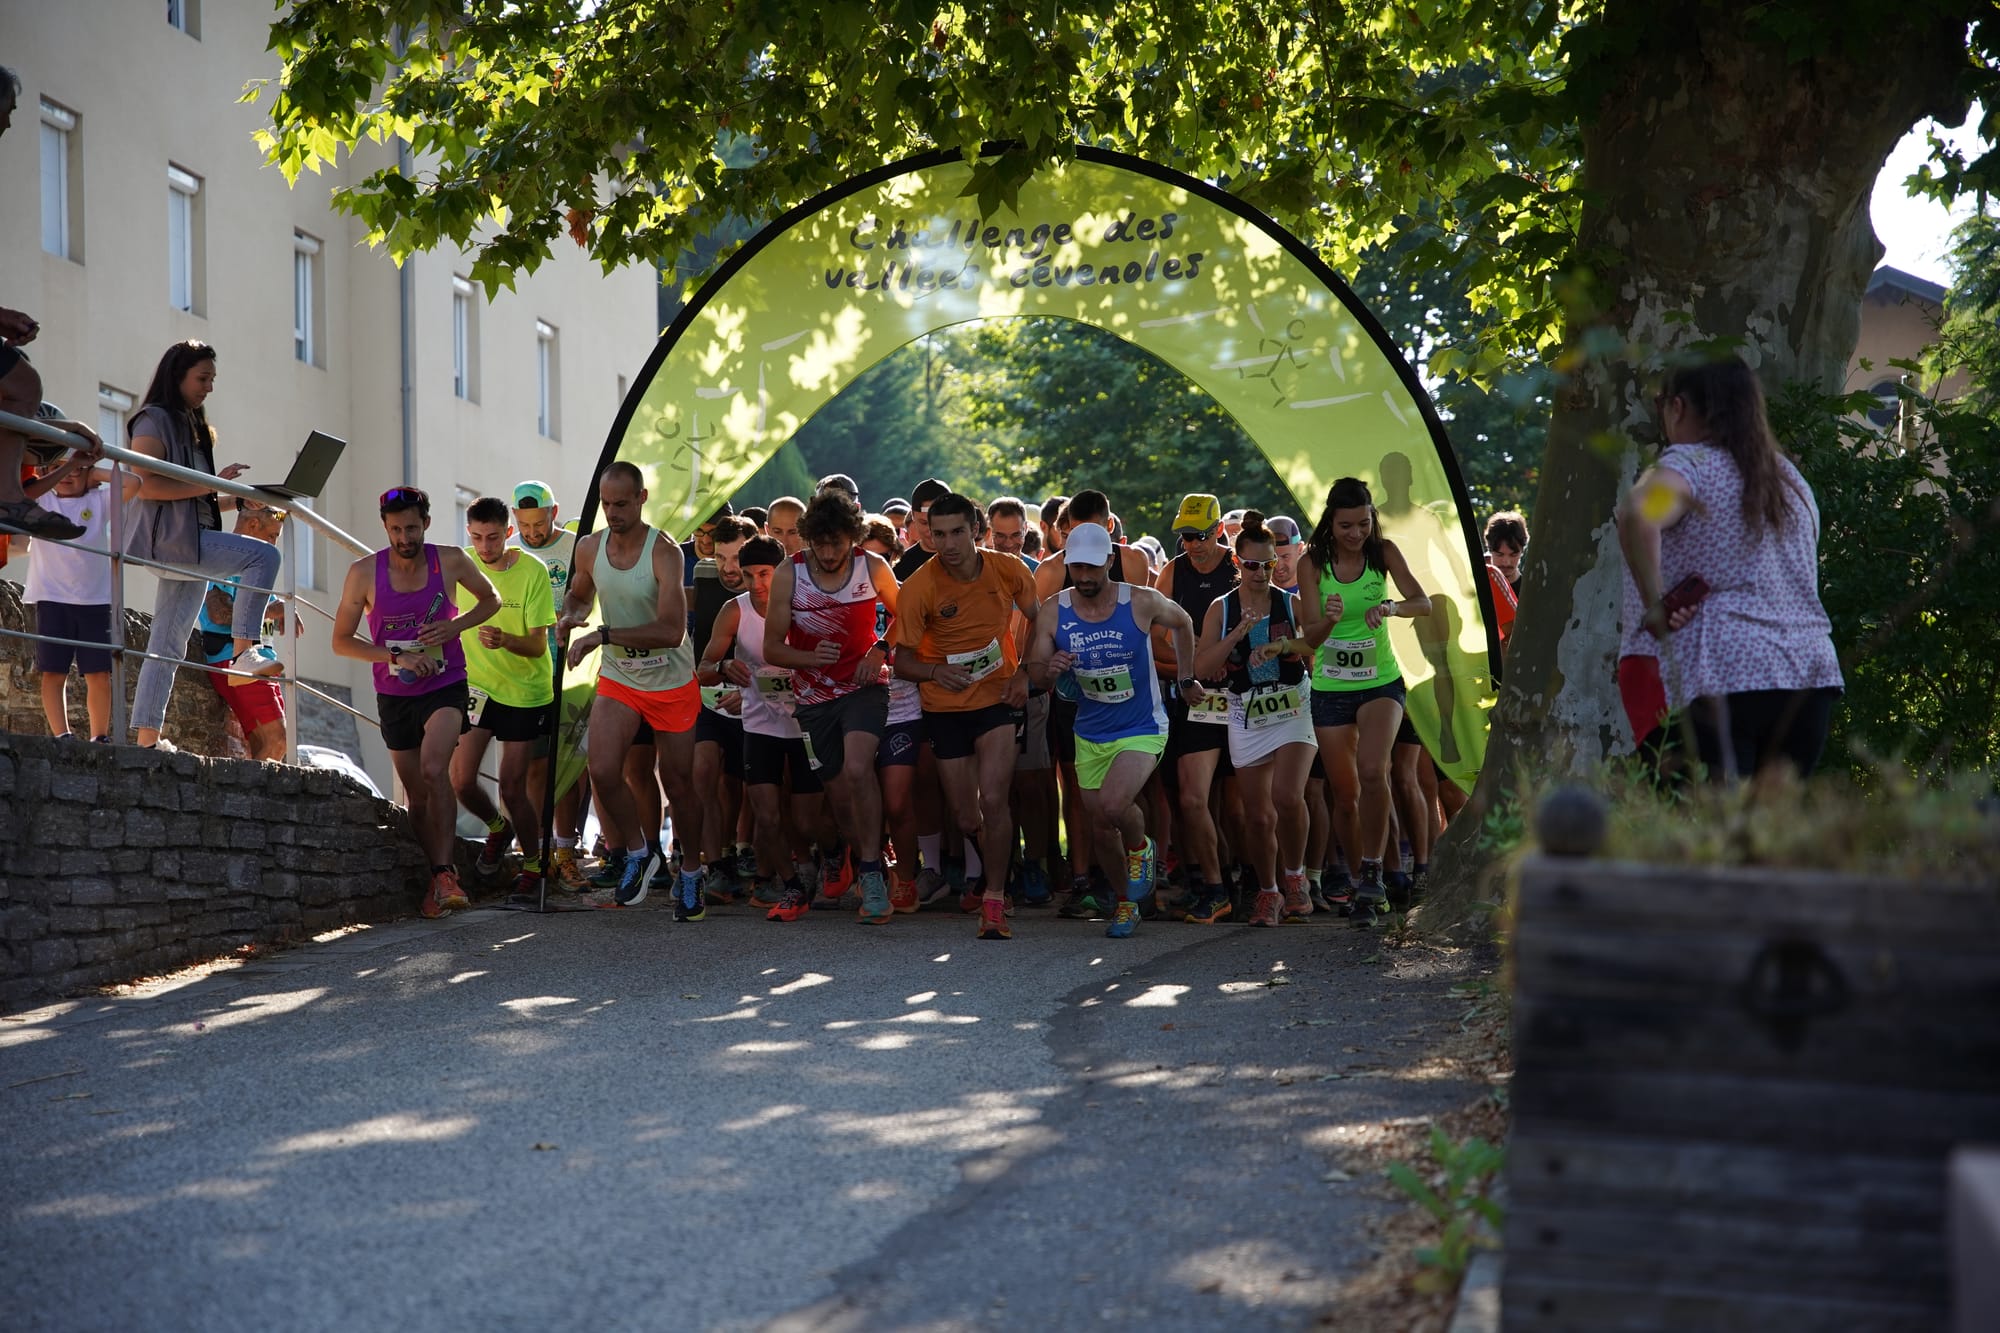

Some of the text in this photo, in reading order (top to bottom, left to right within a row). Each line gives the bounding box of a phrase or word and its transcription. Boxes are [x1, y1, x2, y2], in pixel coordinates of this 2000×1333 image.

[851, 212, 1178, 259] Challenge des
[1009, 252, 1204, 288] cévenoles
[964, 656, 990, 674] 73
[1336, 651, 1363, 667] 90
[1090, 678, 1117, 692] 18
[1205, 696, 1228, 712] 13
[1252, 694, 1290, 715] 101
